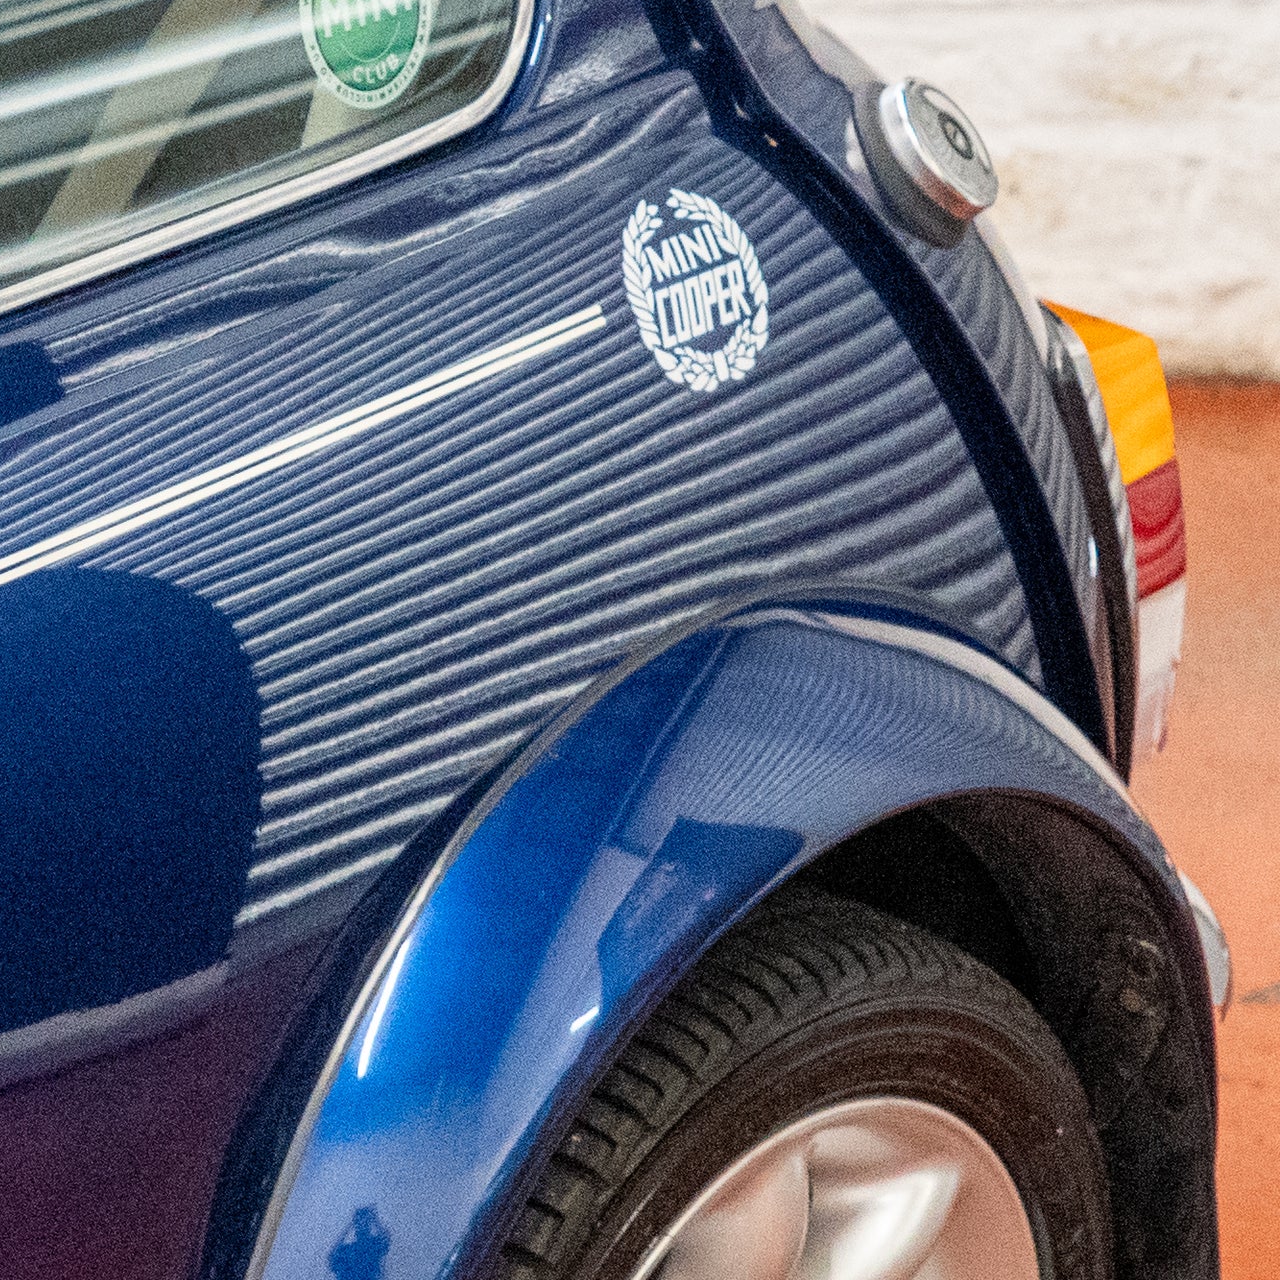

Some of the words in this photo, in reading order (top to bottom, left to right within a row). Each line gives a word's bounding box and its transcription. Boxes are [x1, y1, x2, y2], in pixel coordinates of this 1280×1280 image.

[350, 53, 400, 84] CLUB
[645, 224, 722, 282] MINI
[655, 259, 752, 349] COOPER
